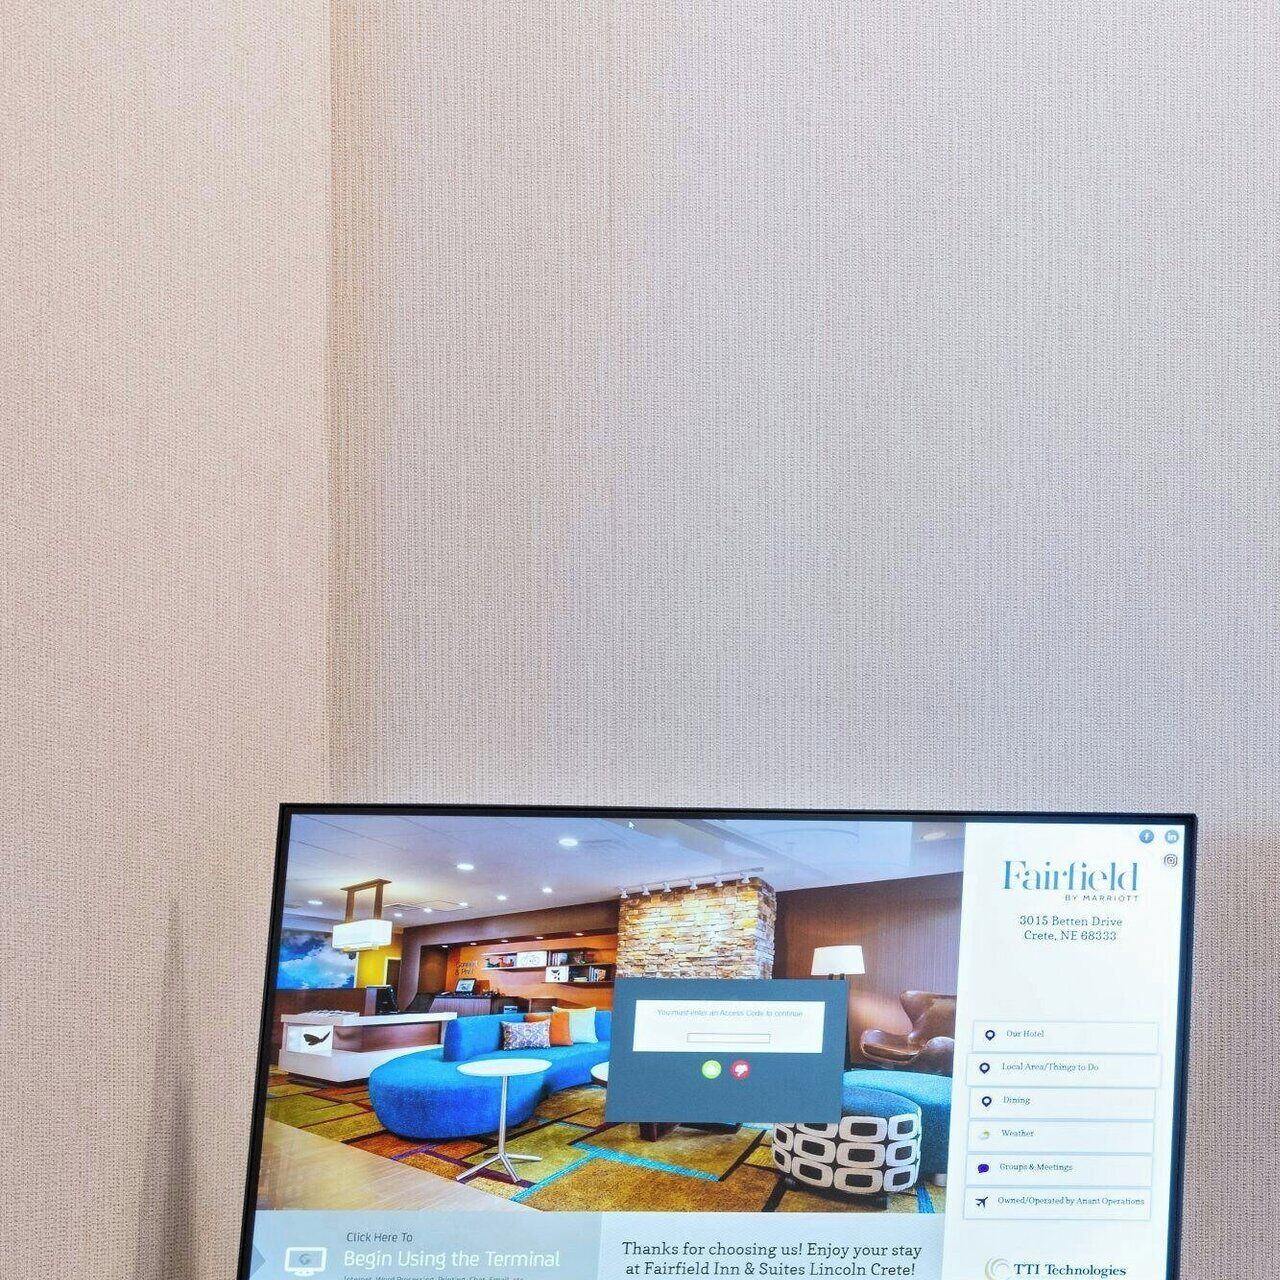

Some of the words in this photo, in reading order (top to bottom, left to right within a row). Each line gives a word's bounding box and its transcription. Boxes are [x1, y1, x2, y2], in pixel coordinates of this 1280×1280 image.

[1003, 860, 1138, 891] Fairfield
[1019, 915, 1048, 926] 3015
[1052, 916, 1088, 926] Betten
[1092, 917, 1123, 927] Drive
[1024, 930, 1058, 942] Crete,
[1060, 931, 1078, 941] NE
[1081, 931, 1117, 941] 68333
[1006, 1029, 1022, 1038] Our
[1024, 1029, 1044, 1038] Hotel
[1002, 1062, 1024, 1071] Local
[1078, 1063, 1086, 1071] to
[1088, 1063, 1099, 1071] Do
[1003, 1096, 1030, 1105] Dining
[1001, 1129, 1034, 1137] Weather
[999, 1163, 1028, 1172] Groups
[1029, 1163, 1035, 1171] &
[1036, 1163, 1073, 1172] Meetings
[1065, 1197, 1075, 1206] by
[1101, 1197, 1144, 1207] Operations
[346, 1232, 371, 1243] Click
[374, 1232, 398, 1243] Here
[401, 1232, 413, 1243] To
[622, 1241, 679, 1256] Thanks
[683, 1242, 705, 1256] for
[708, 1242, 777, 1259] choosing
[781, 1243, 803, 1256] us!
[807, 1243, 849, 1259] Enjoy
[852, 1246, 888, 1260] your
[891, 1244, 922, 1259] stay
[344, 1250, 392, 1270] Begin
[398, 1250, 446, 1270] Using
[451, 1251, 479, 1267] the
[485, 1251, 561, 1268] Terminal
[625, 1263, 641, 1275] at
[644, 1261, 709, 1276] Fairfield
[713, 1262, 740, 1275] Inn
[744, 1262, 755, 1275] &
[759, 1262, 805, 1276] Suites
[809, 1263, 866, 1276] Lincoln
[870, 1263, 915, 1276] Crete!
[1013, 1263, 1040, 1275] TTI
[1045, 1263, 1127, 1278] Technologies
